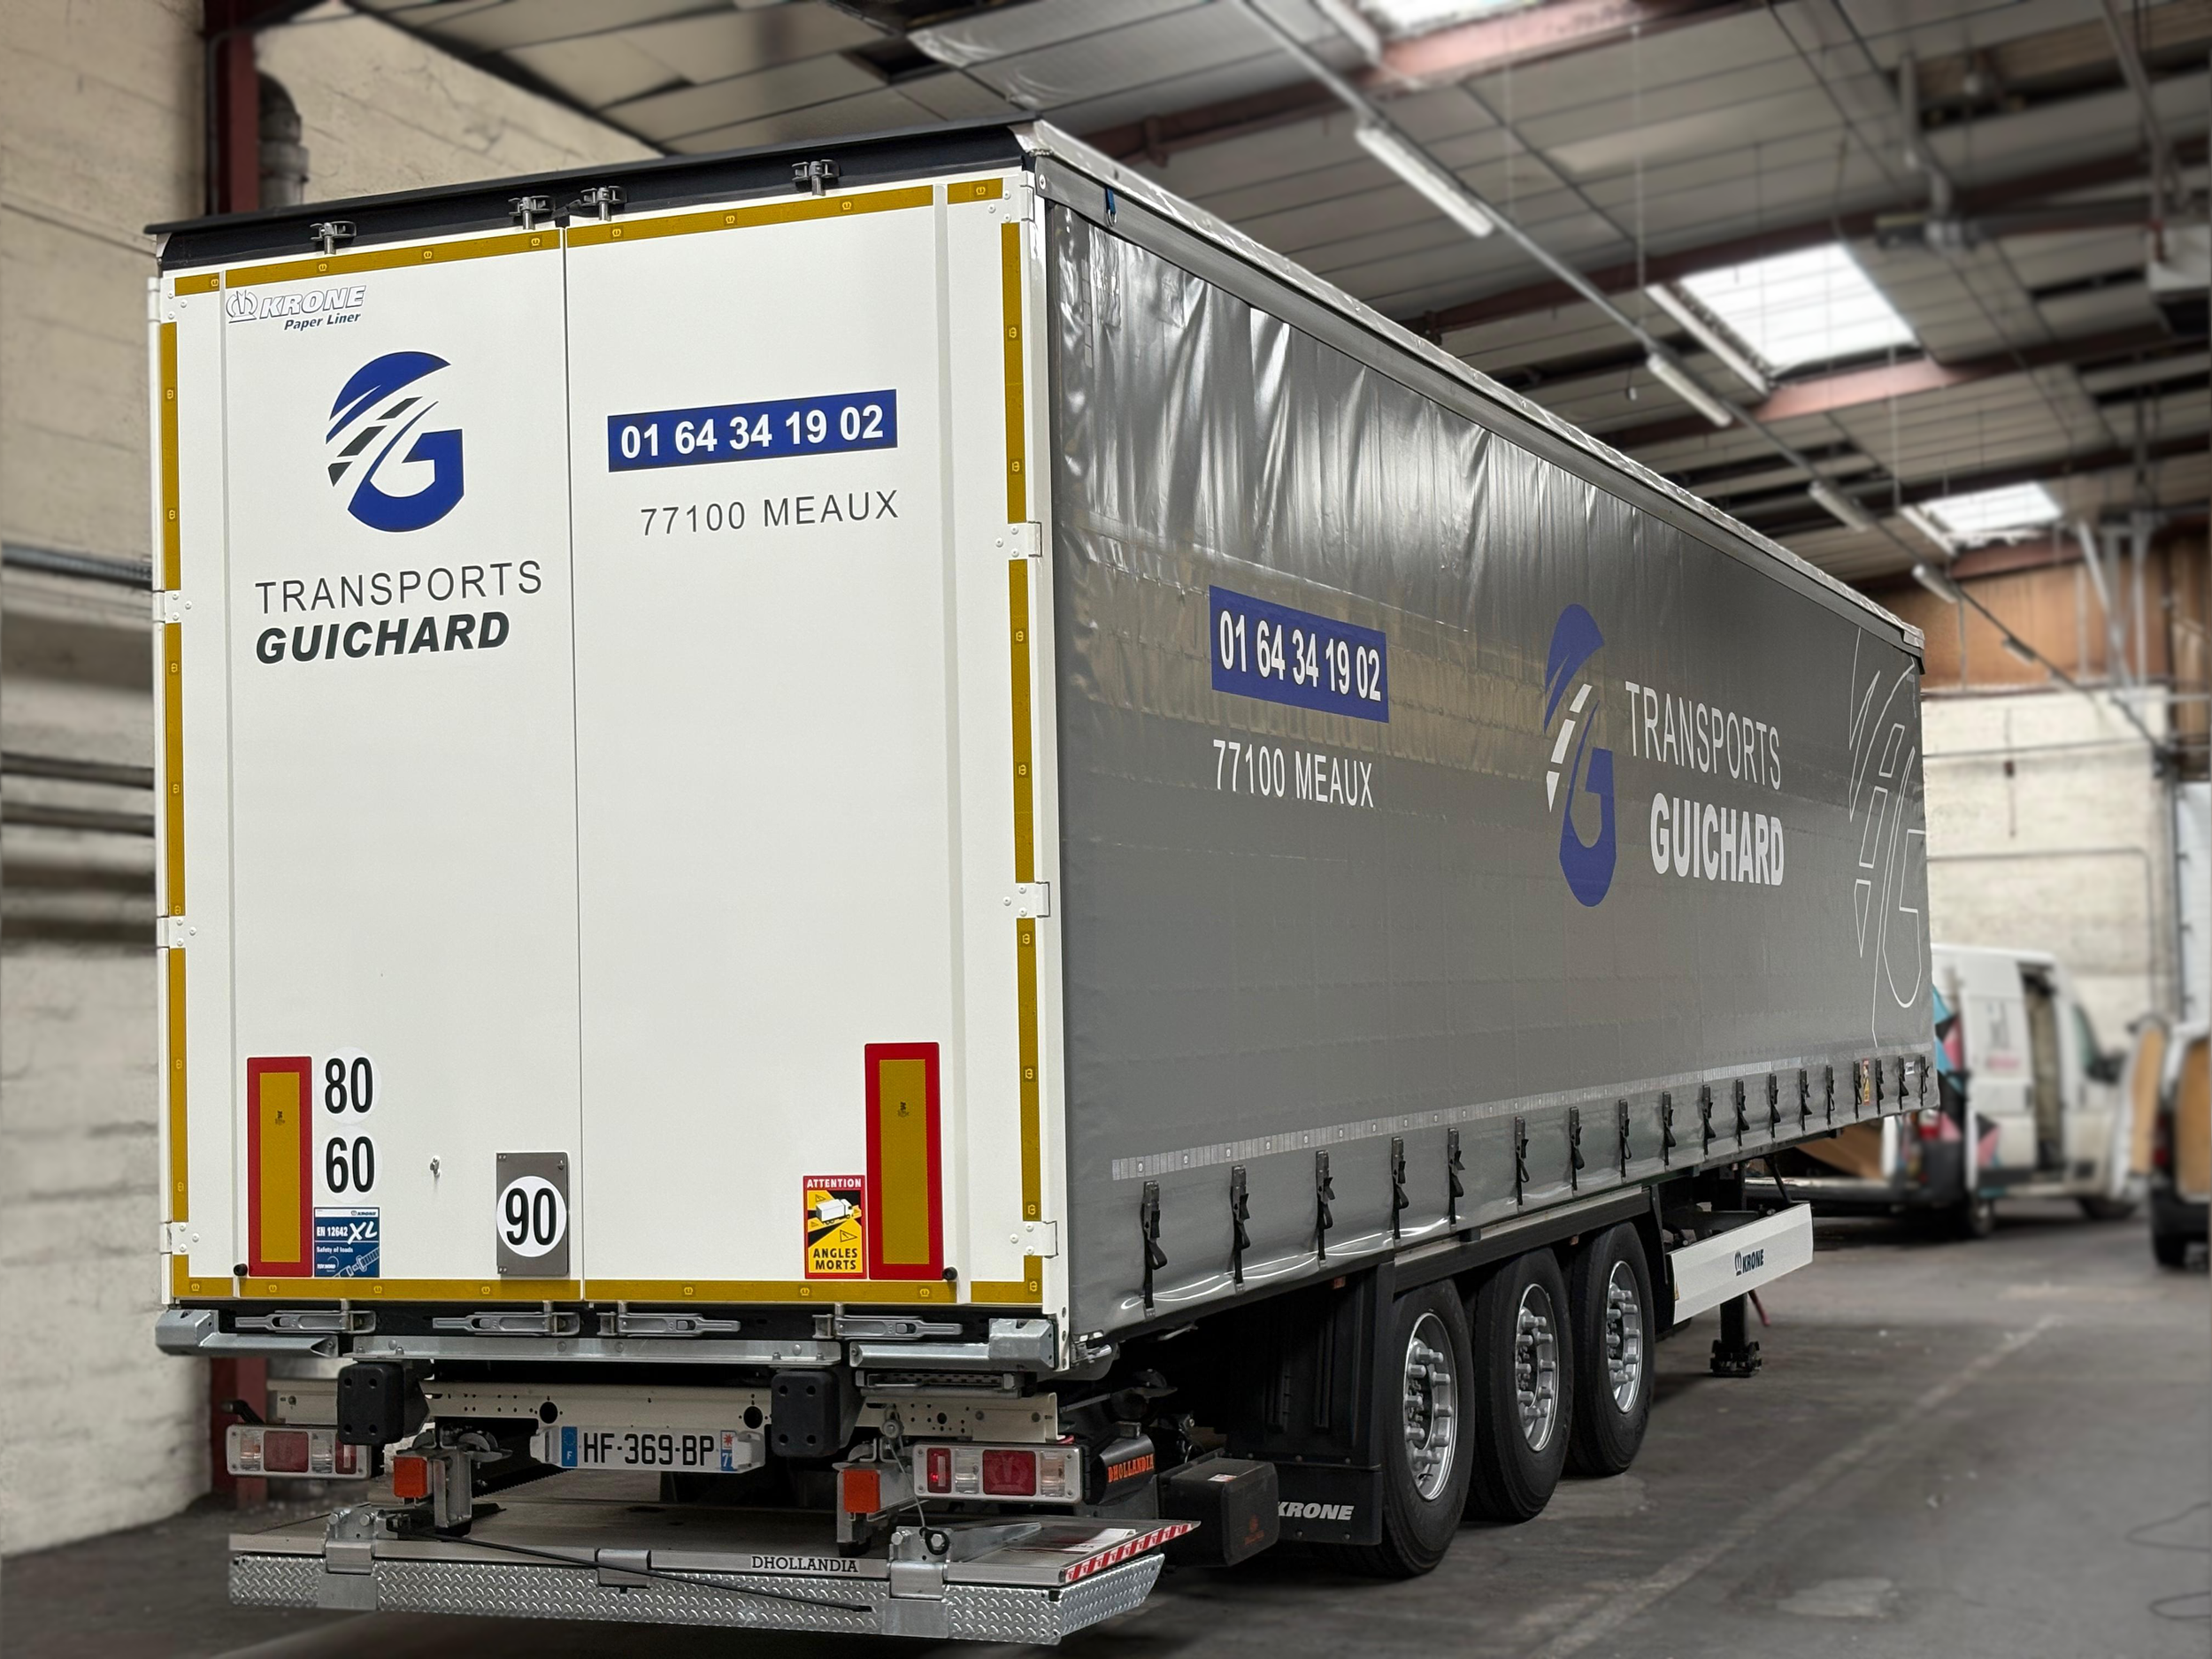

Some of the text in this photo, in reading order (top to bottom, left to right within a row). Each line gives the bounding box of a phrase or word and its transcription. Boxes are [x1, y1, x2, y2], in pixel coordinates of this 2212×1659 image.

[259, 285, 366, 319] KRONE
[284, 312, 361, 331] Paper Liner
[621, 404, 883, 458] 01 64 34 19 02
[641, 489, 899, 536] 77100 MEAUX
[255, 559, 542, 614] TRANSPORTS
[256, 611, 510, 664] GUICHARD
[1220, 611, 1381, 702] 01 64 34 19 02
[1625, 680, 1781, 790] TRANSPORTS
[1213, 739, 1374, 808] 77100 MEAUX
[1650, 792, 1784, 886] GUICHARD
[324, 1056, 373, 1115] 80
[325, 1135, 375, 1194] 60
[806, 1178, 862, 1189] ATTENTION
[316, 1221, 378, 1245] EN 12642 XL
[505, 1187, 557, 1246] 90
[813, 1248, 858, 1259] ANGLES
[815, 1259, 856, 1270] MORTS
[1742, 1248, 1764, 1274] KRONE
[566, 1450, 573, 1460] F
[583, 1432, 715, 1466] HF-369-BP
[1108, 1453, 1155, 1484] DHOLLANDIA
[1278, 1501, 1355, 1521] KRONE
[751, 1555, 858, 1573] DHOLLANDIA
